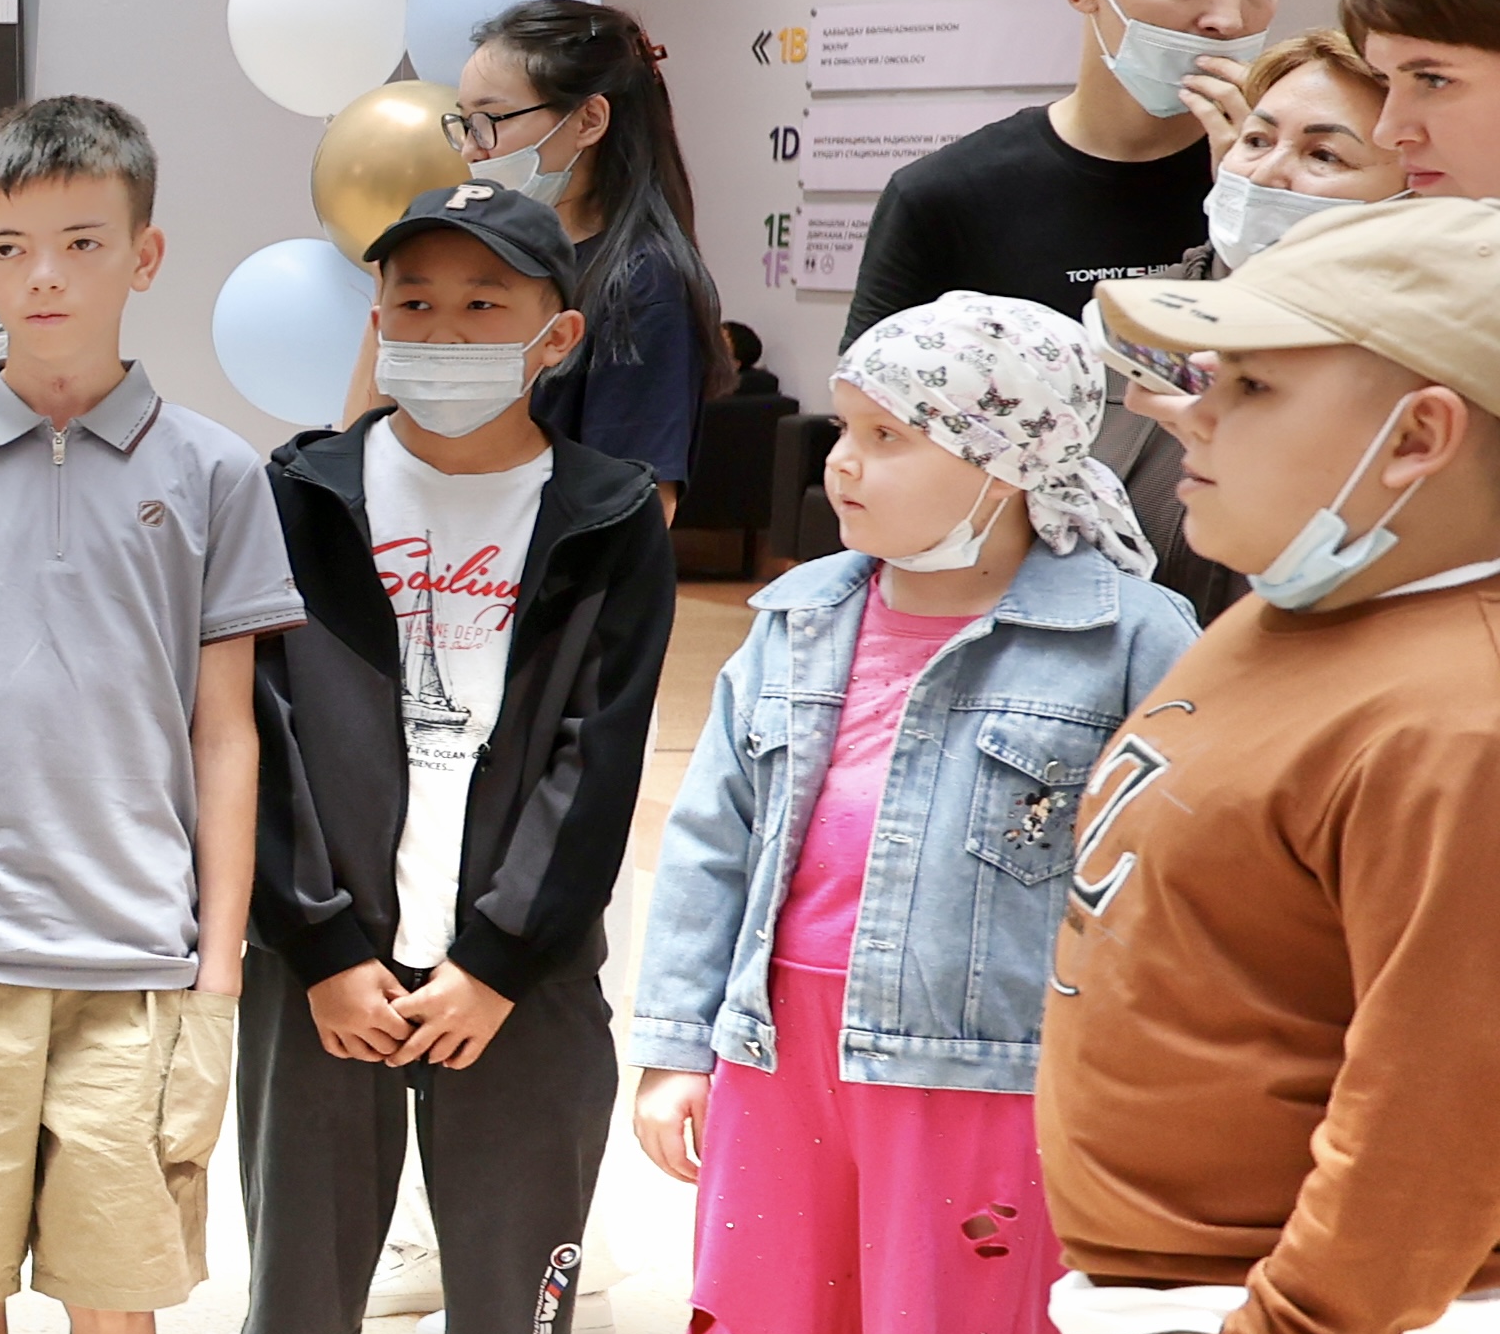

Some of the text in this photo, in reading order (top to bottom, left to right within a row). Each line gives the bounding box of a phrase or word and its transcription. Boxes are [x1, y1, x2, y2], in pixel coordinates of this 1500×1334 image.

[778, 27, 808, 63] 1B
[770, 126, 800, 161] 1D
[445, 184, 495, 210] P
[764, 213, 791, 248] 1E
[1065, 267, 1126, 283] TOMMY
